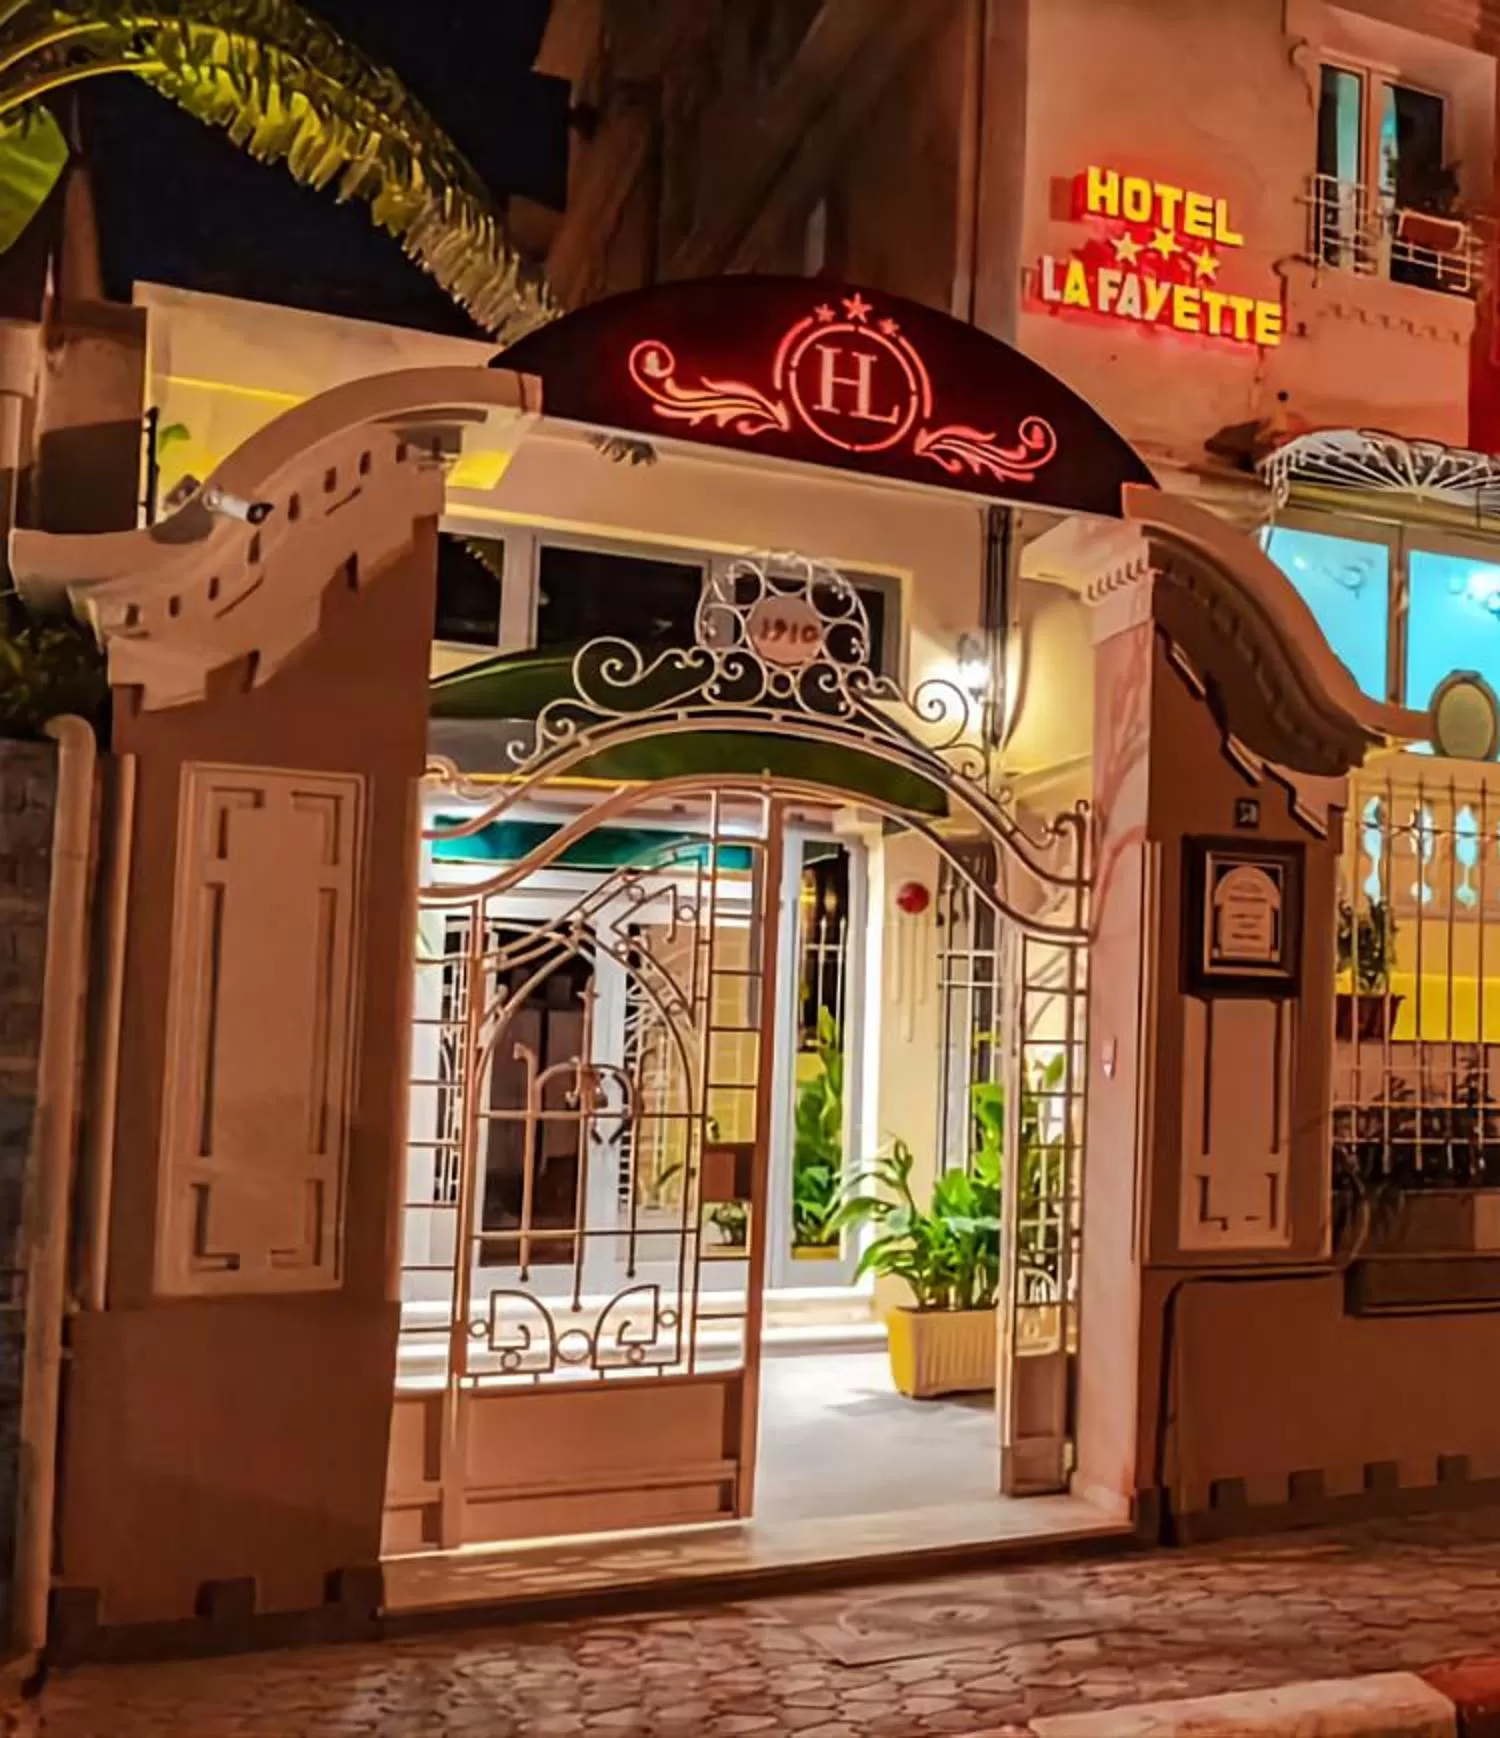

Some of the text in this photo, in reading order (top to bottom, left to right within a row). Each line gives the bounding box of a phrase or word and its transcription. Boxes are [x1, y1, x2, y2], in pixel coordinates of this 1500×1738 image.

[1087, 165, 1243, 246] HOTEL
[1042, 255, 1282, 347] LA FAYETTE
[812, 344, 900, 424] HL
[760, 616, 820, 645] 1910
